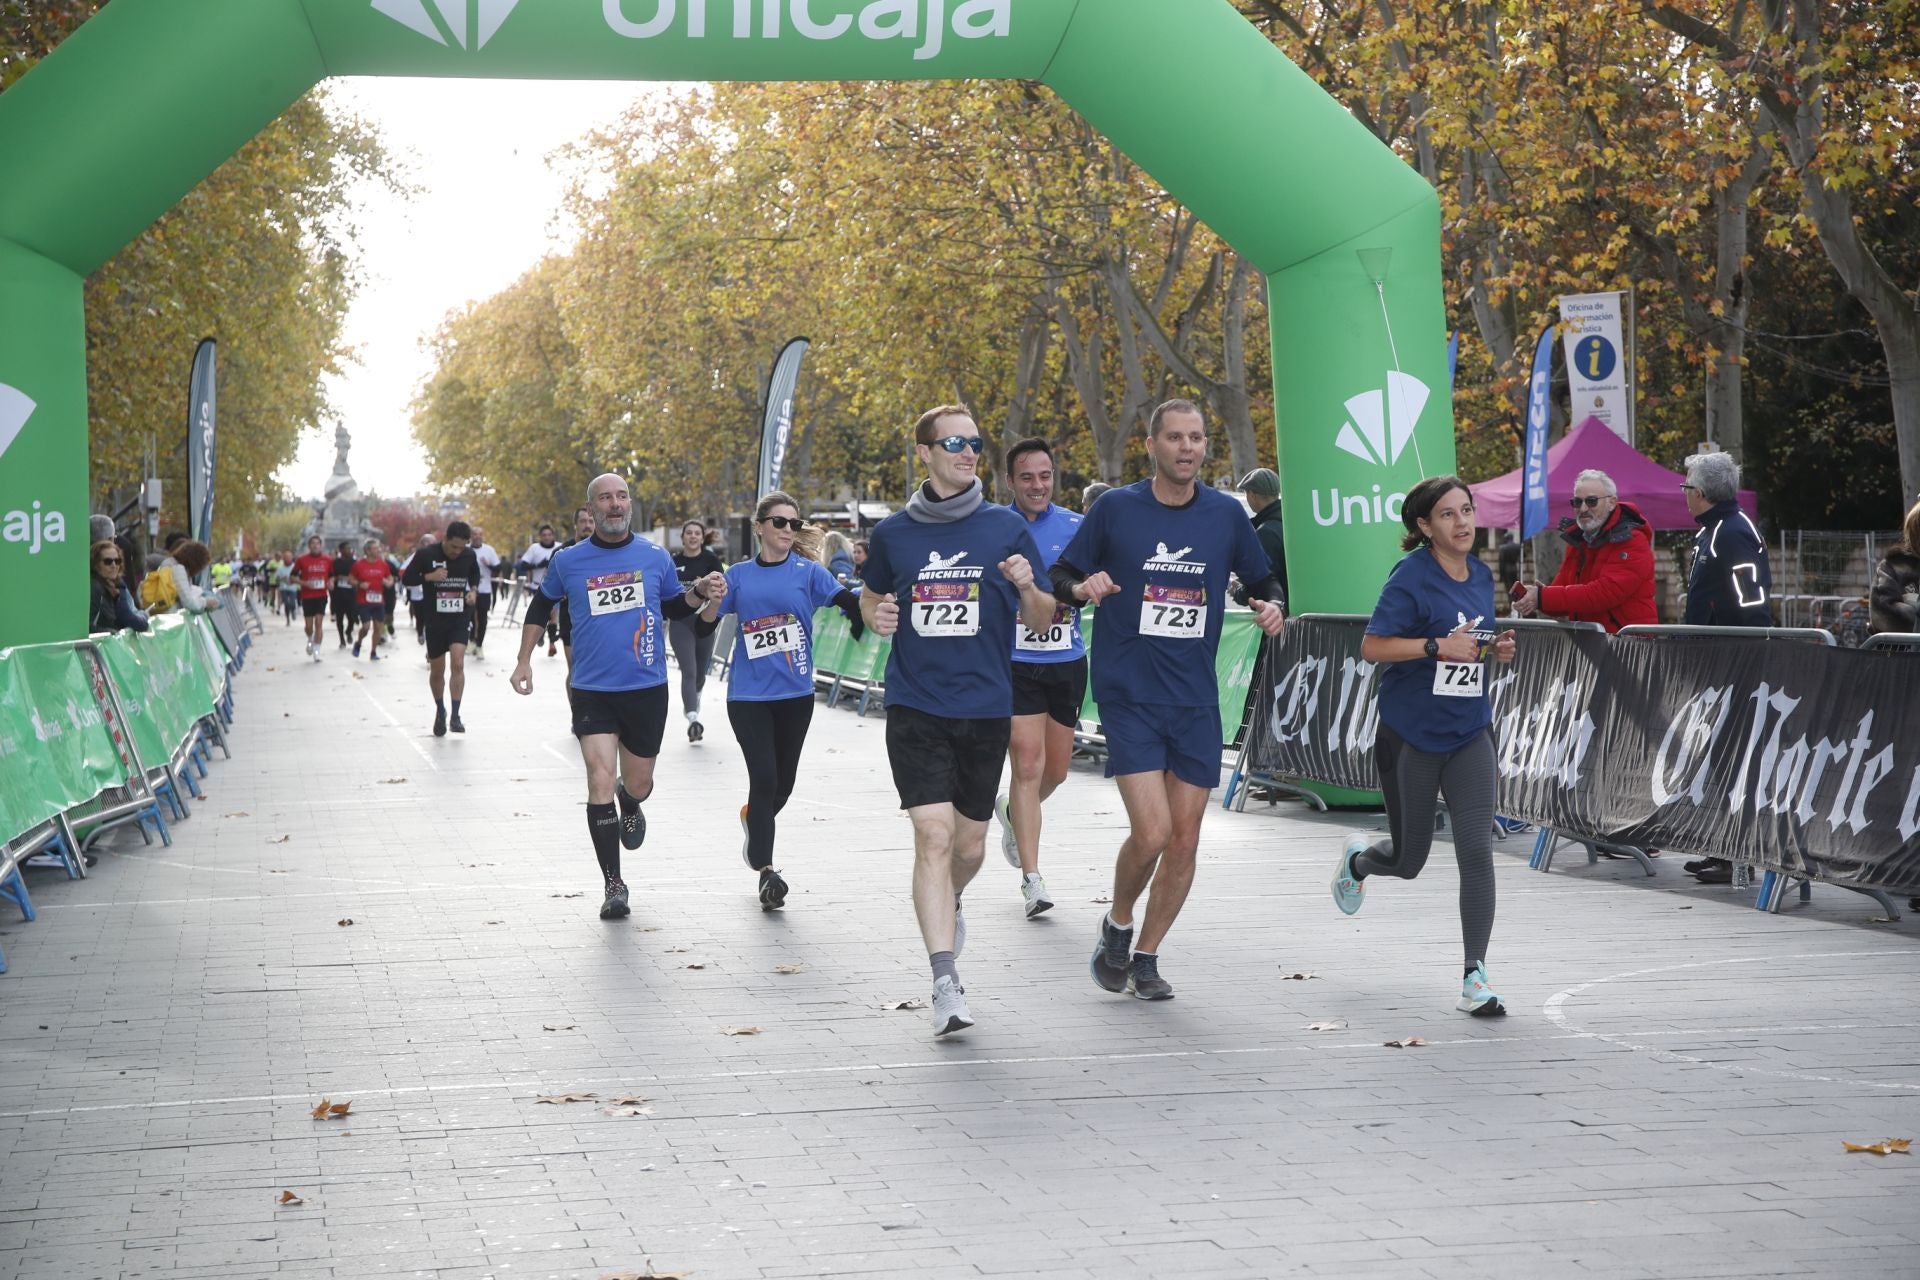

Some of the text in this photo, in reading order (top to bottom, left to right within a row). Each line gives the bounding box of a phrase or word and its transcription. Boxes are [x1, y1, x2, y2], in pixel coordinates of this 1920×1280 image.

[1567, 302, 1604, 312] Oficina de
[918, 569, 982, 581] MICHELIN
[1142, 562, 1206, 575] MICHELIN
[441, 600, 460, 608] 514
[597, 586, 637, 606] 282
[920, 604, 968, 626] 722
[1152, 605, 1198, 628] 723
[643, 609, 655, 666] elecnor
[752, 628, 788, 650] 281
[1024, 626, 1062, 643] 280
[1445, 665, 1479, 686] 724
[1651, 683, 1734, 808] El
[1728, 681, 1893, 836] Norte
